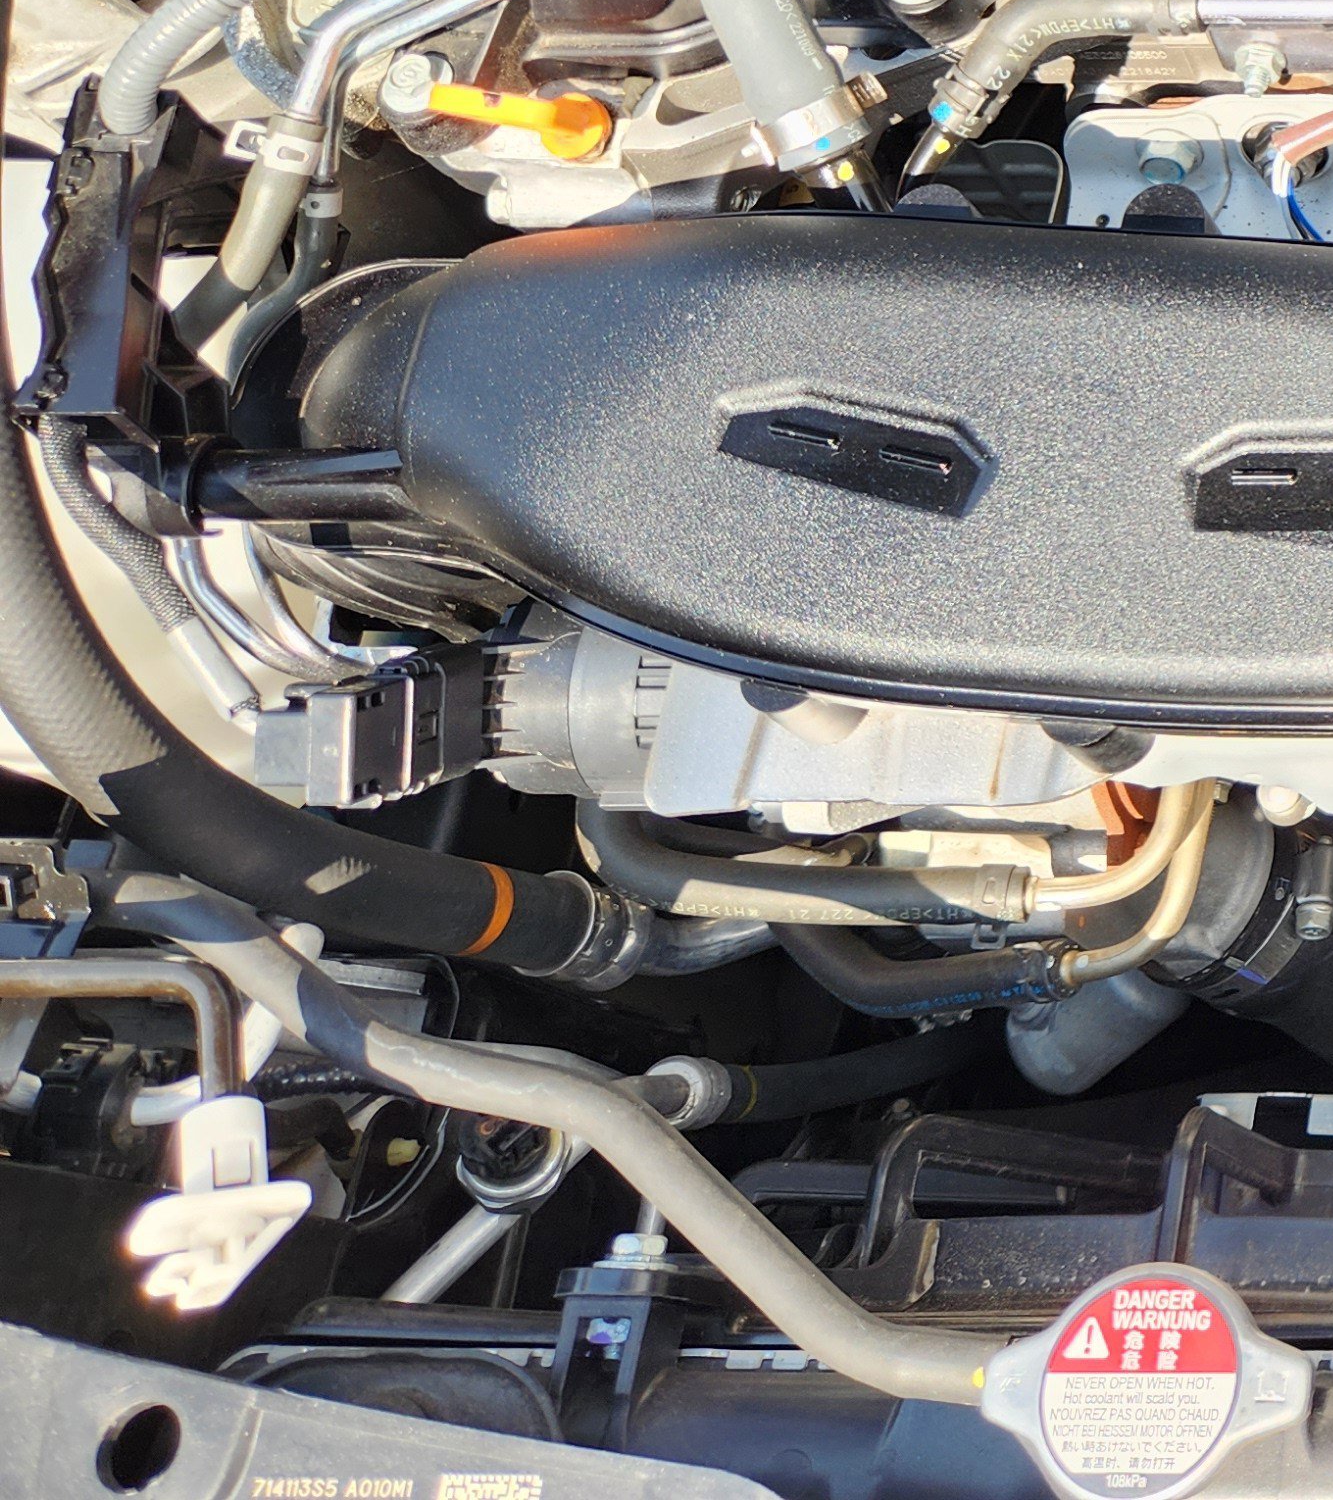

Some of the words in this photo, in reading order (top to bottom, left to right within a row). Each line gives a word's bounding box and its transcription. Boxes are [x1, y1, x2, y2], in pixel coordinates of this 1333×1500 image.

[1113, 1289, 1197, 1311] DANGER
[1111, 1310, 1212, 1331] WARNUNG
[1065, 1377, 1107, 1390] NEVER
[1109, 1377, 1144, 1390] OPEN
[1146, 1377, 1183, 1390] WHEN
[1186, 1377, 1215, 1390] HOT.
[1063, 1393, 1083, 1405] Hot
[1084, 1392, 1124, 1405] coolant
[1126, 1392, 1144, 1405] will
[1145, 1392, 1176, 1405] scald
[1177, 1395, 1201, 1408] you.
[1050, 1408, 1108, 1421] N'OUVREZ
[1109, 1408, 1132, 1421] PAS
[1134, 1408, 1176, 1421] QUAND
[1052, 1424, 1081, 1437] NICHT
[1081, 1424, 1097, 1437] BEI
[1097, 1424, 1138, 1437] HEISSEM
[1140, 1424, 1174, 1437] MOTOR
